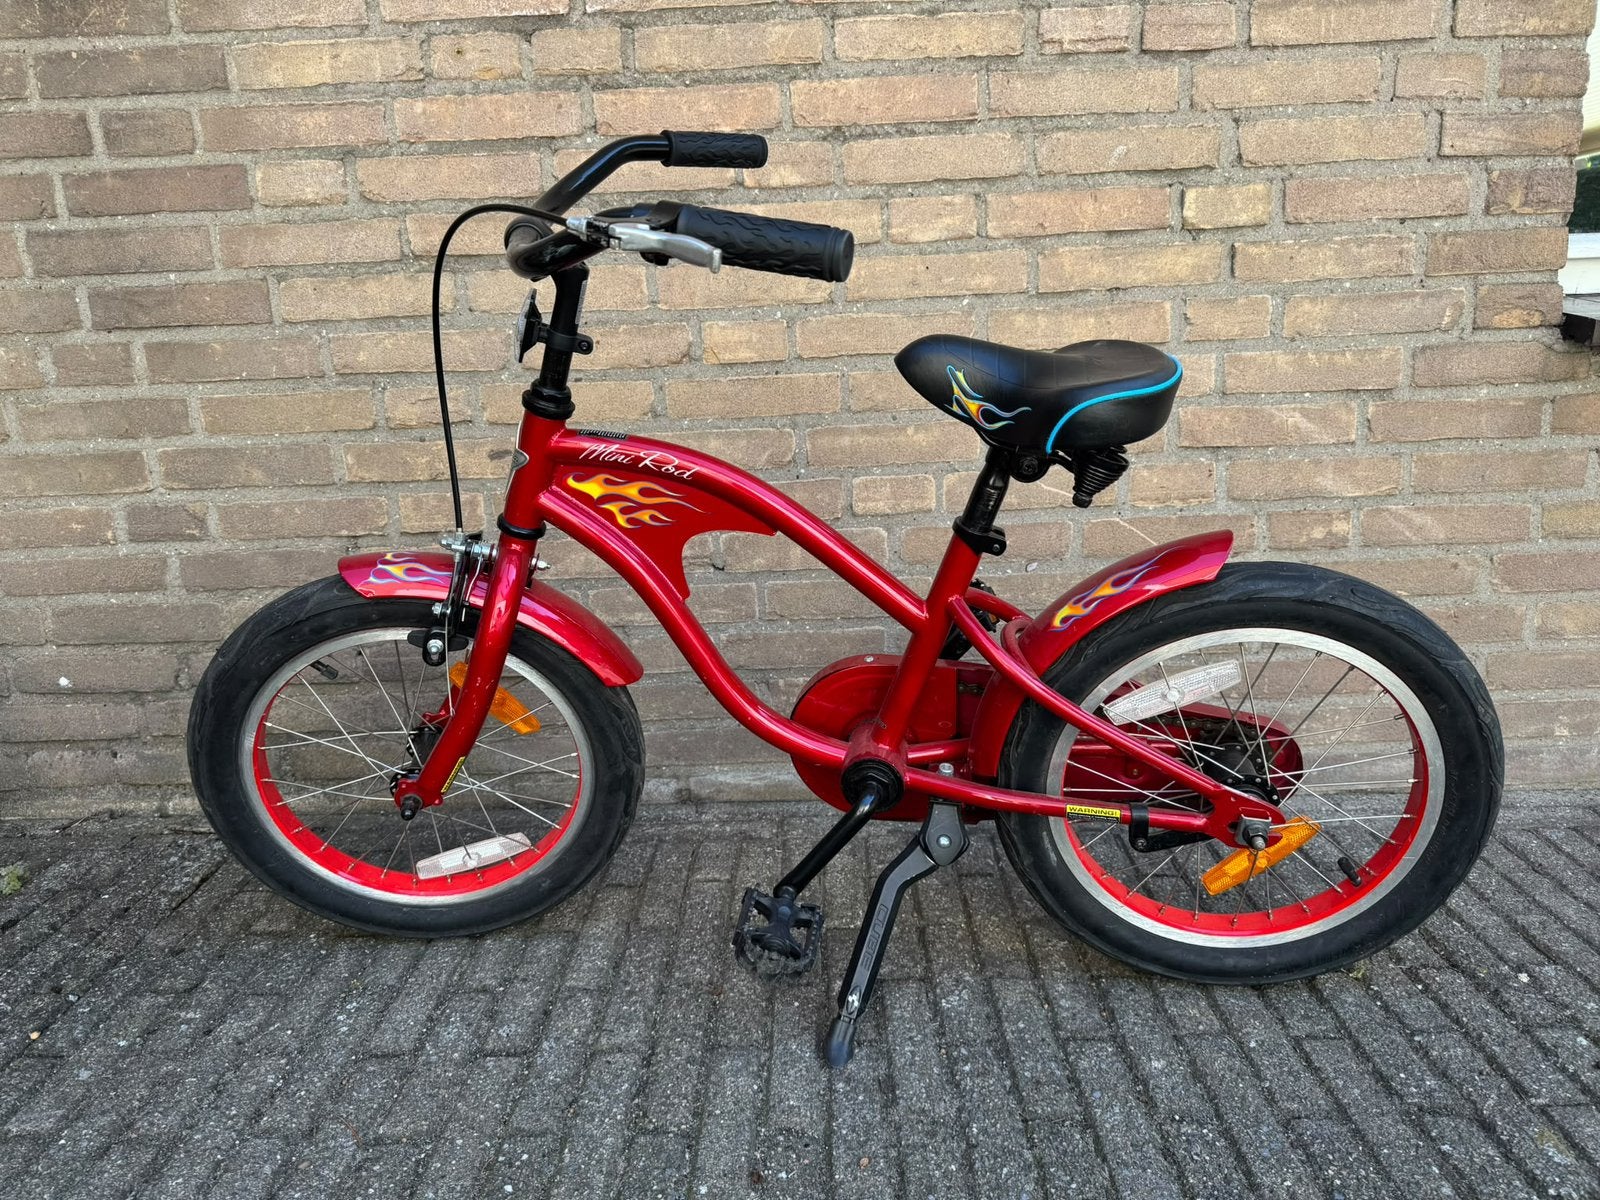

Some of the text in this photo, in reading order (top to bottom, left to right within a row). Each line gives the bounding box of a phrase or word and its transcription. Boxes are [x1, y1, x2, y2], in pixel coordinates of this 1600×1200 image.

[579, 443, 700, 480] Mini Rod
[1068, 806, 1118, 817] WARNING!
[860, 903, 889, 972] CUBE
